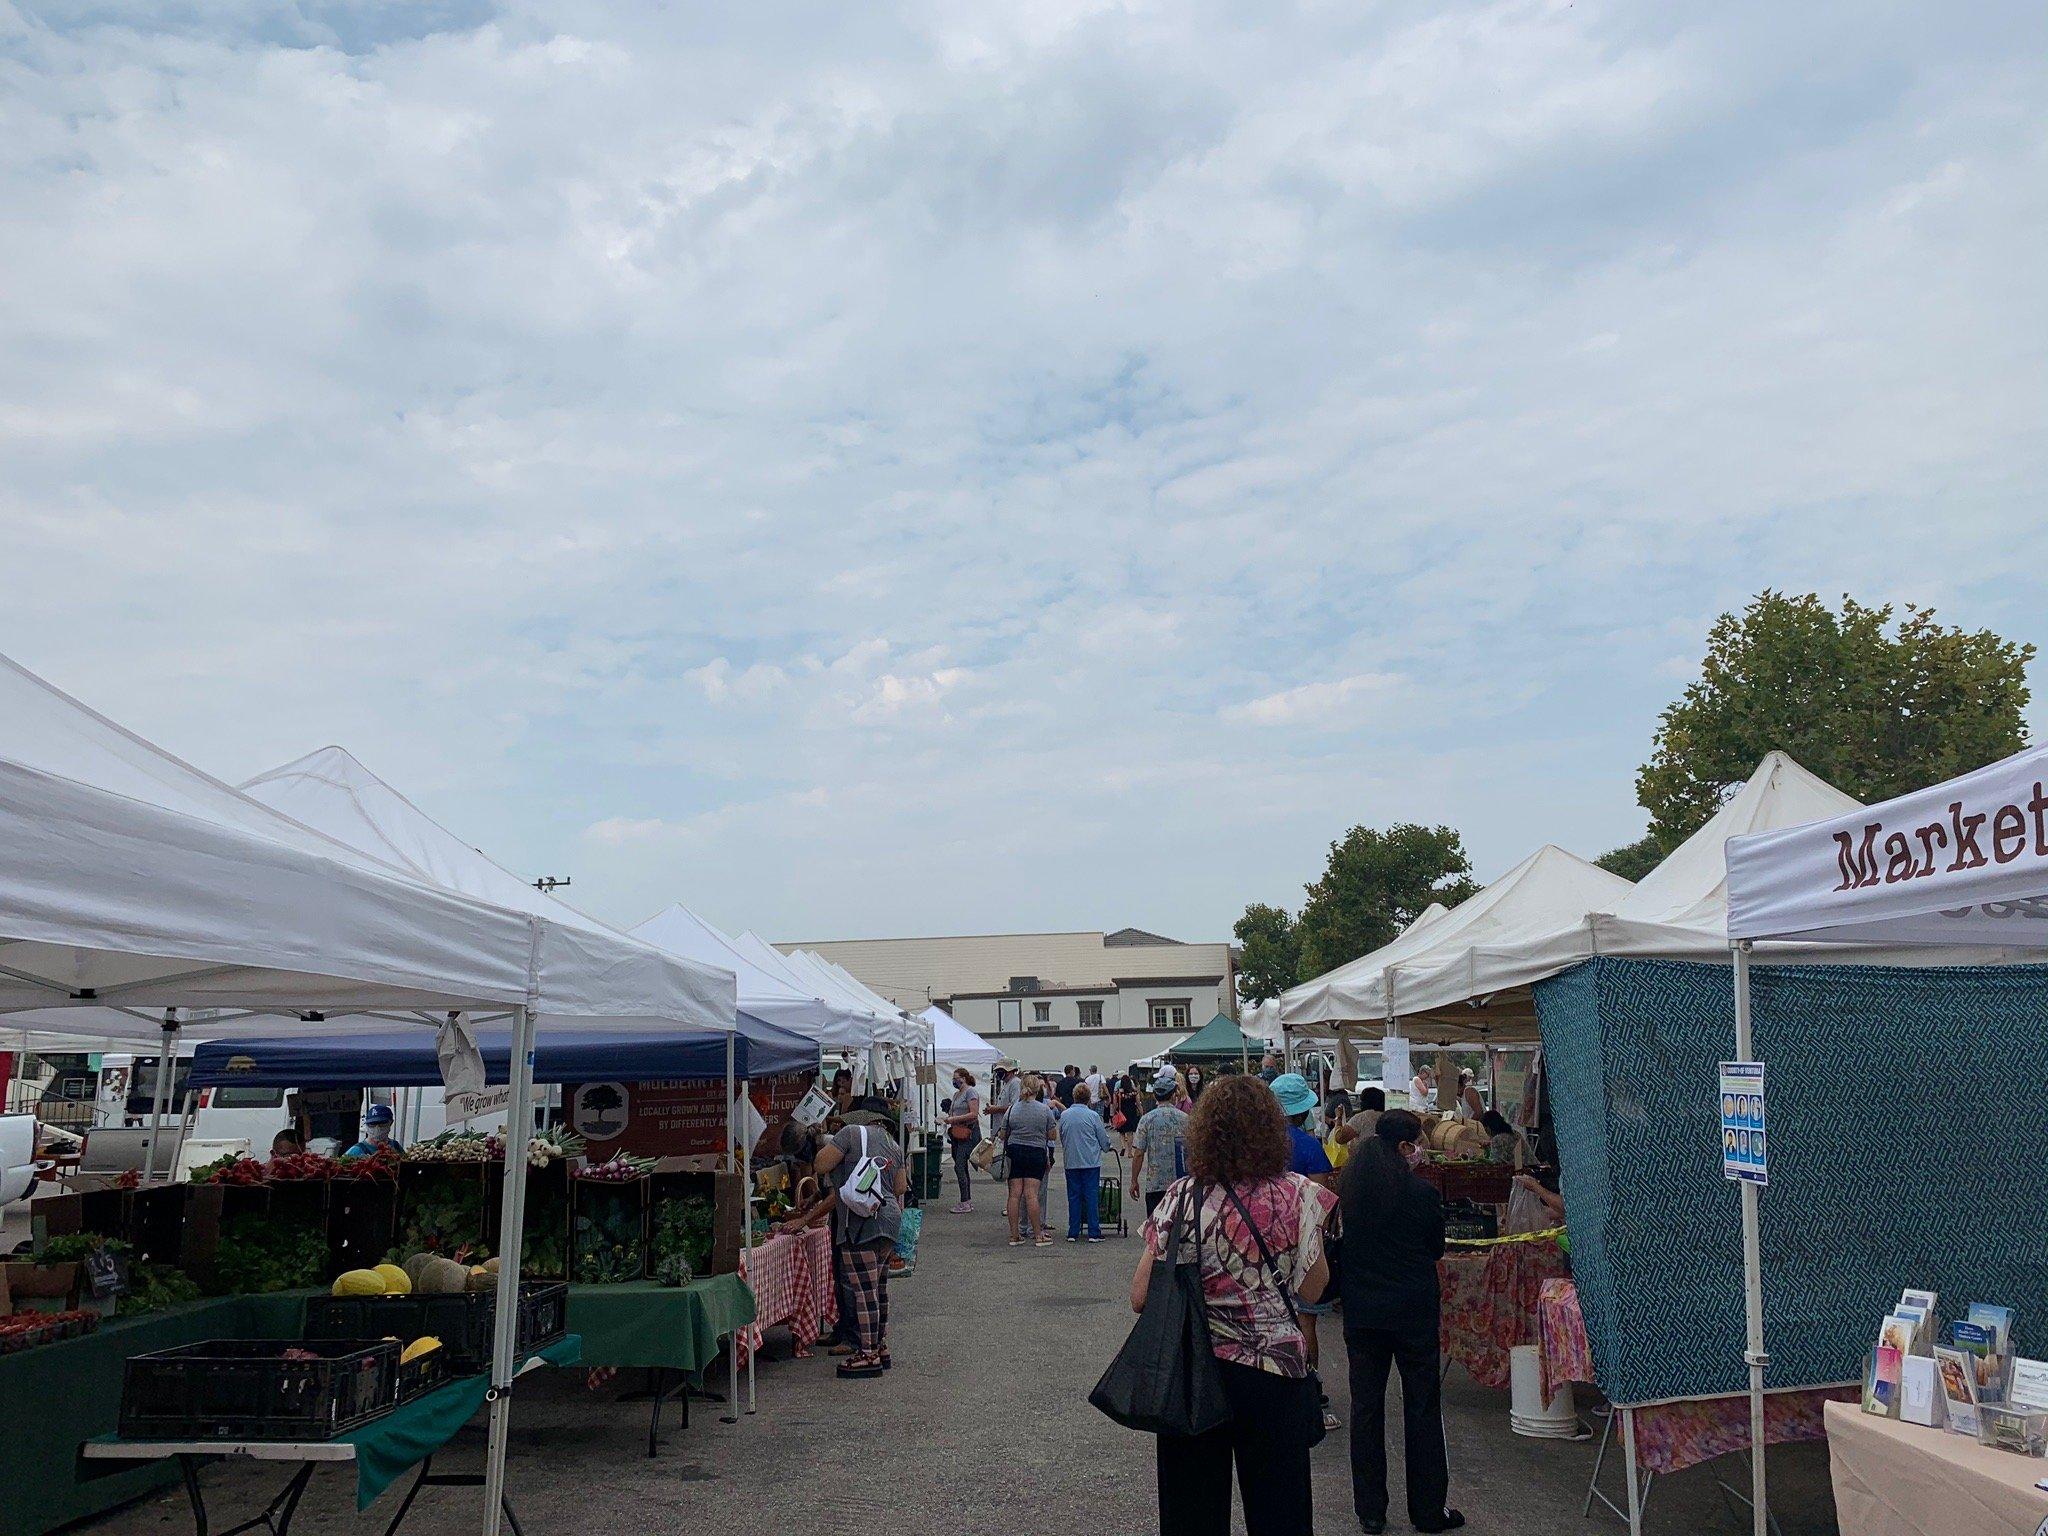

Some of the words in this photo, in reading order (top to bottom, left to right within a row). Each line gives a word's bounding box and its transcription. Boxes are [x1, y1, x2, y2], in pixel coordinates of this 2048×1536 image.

[1832, 781, 2048, 892] Market
[475, 1094, 493, 1114] grow
[639, 1105, 671, 1117] LOCALLY
[672, 1103, 699, 1115] GROWN
[700, 1103, 715, 1114] AND
[659, 1121, 668, 1131] BY
[671, 1118, 717, 1129] DIFFERENTLY
